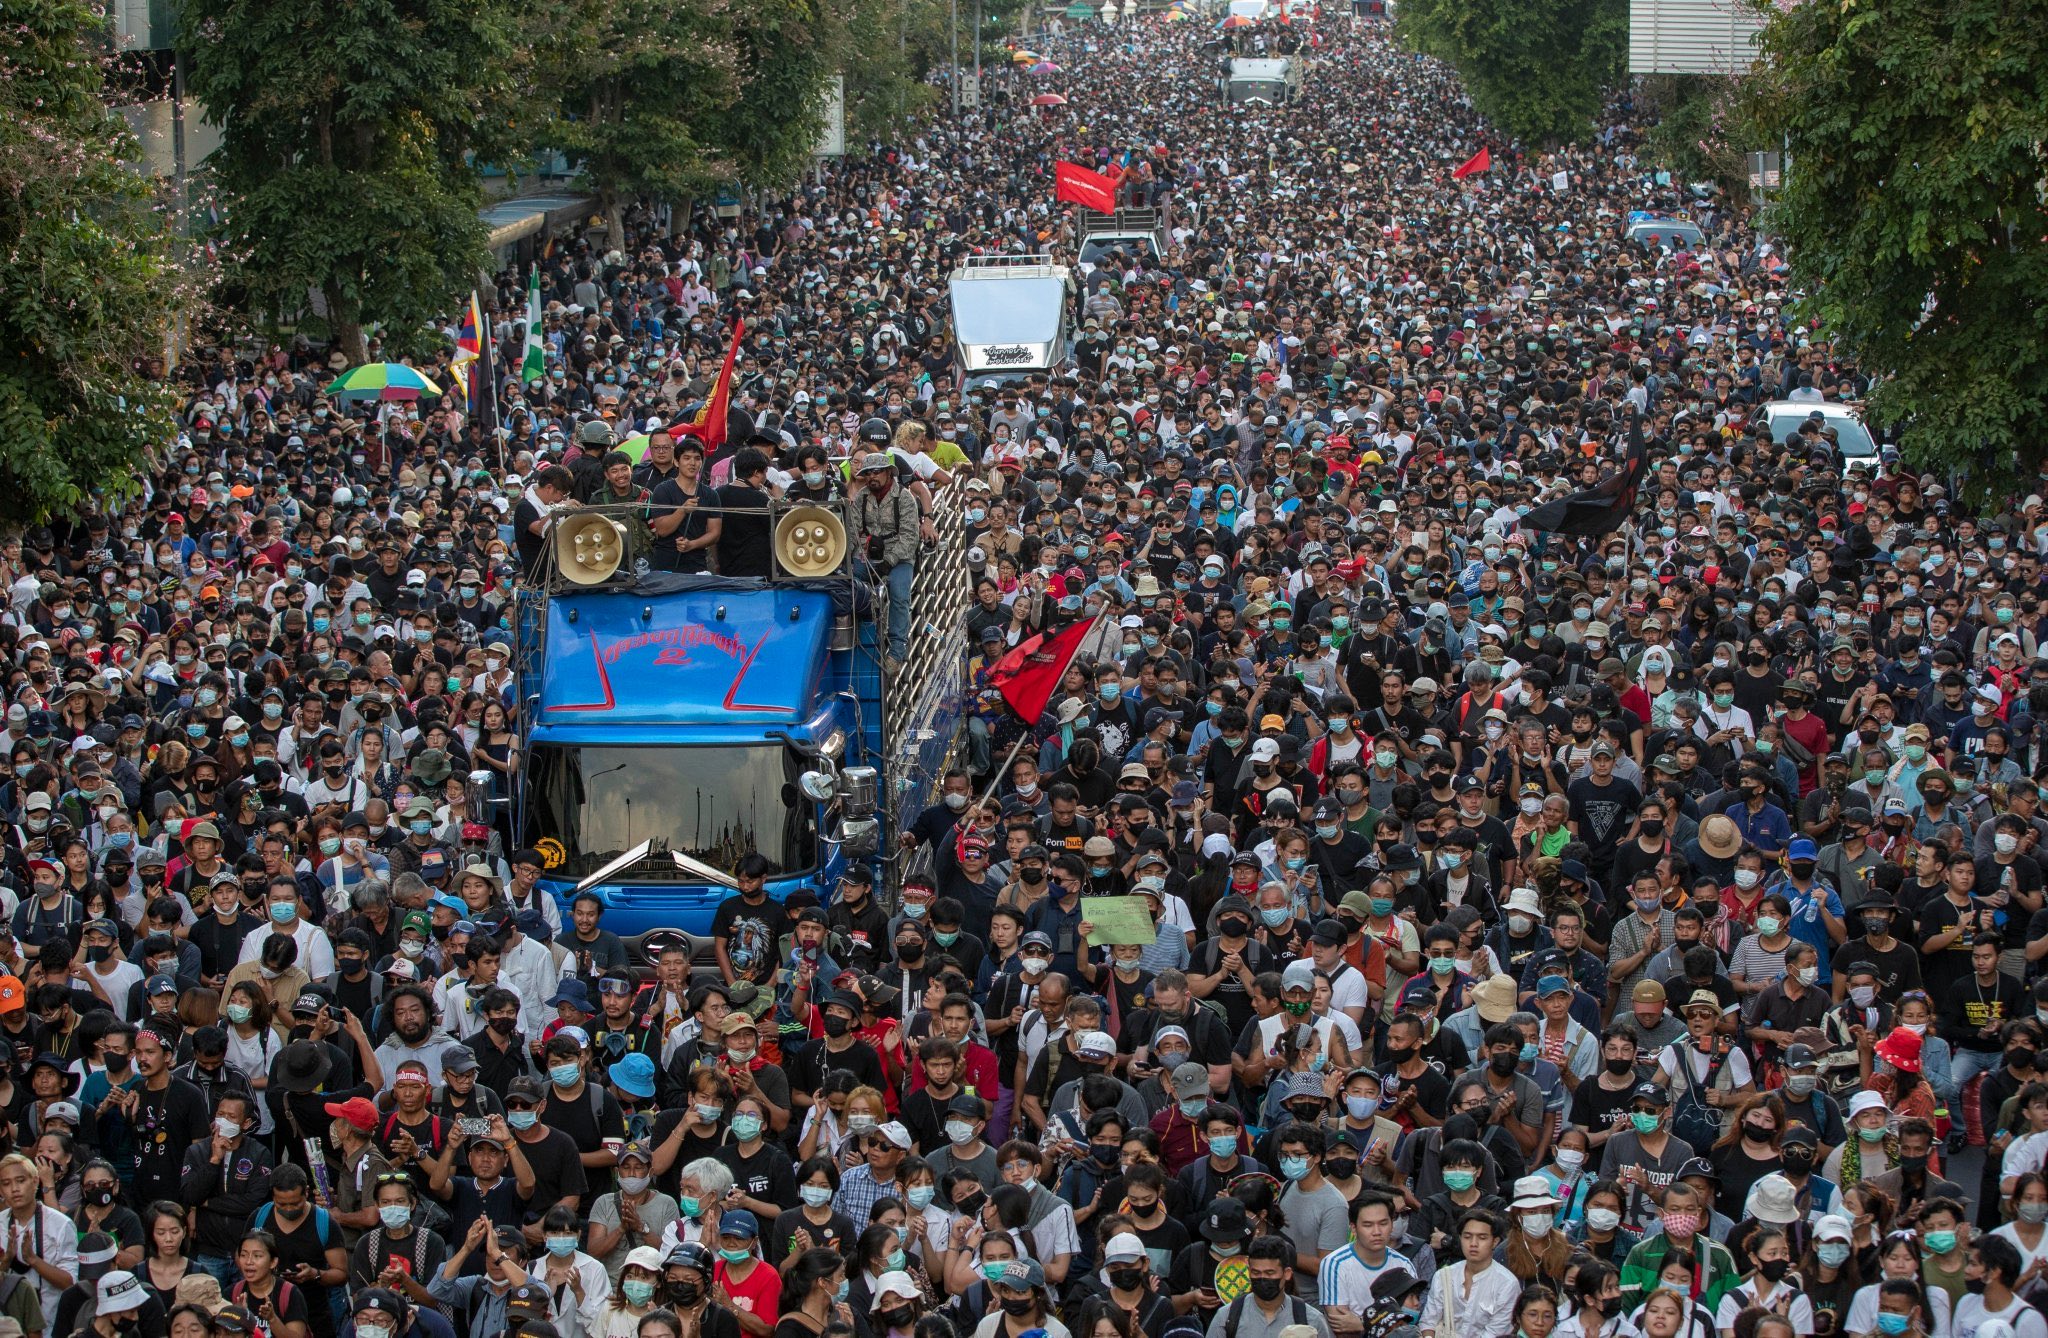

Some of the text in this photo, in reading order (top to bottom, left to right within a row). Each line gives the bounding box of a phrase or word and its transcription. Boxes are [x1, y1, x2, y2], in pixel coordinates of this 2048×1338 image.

[653, 648, 691, 665] 2
[1890, 800, 1906, 808] PAT
[1647, 1170, 1675, 1186] YORK
[748, 1180, 769, 1193] YET
